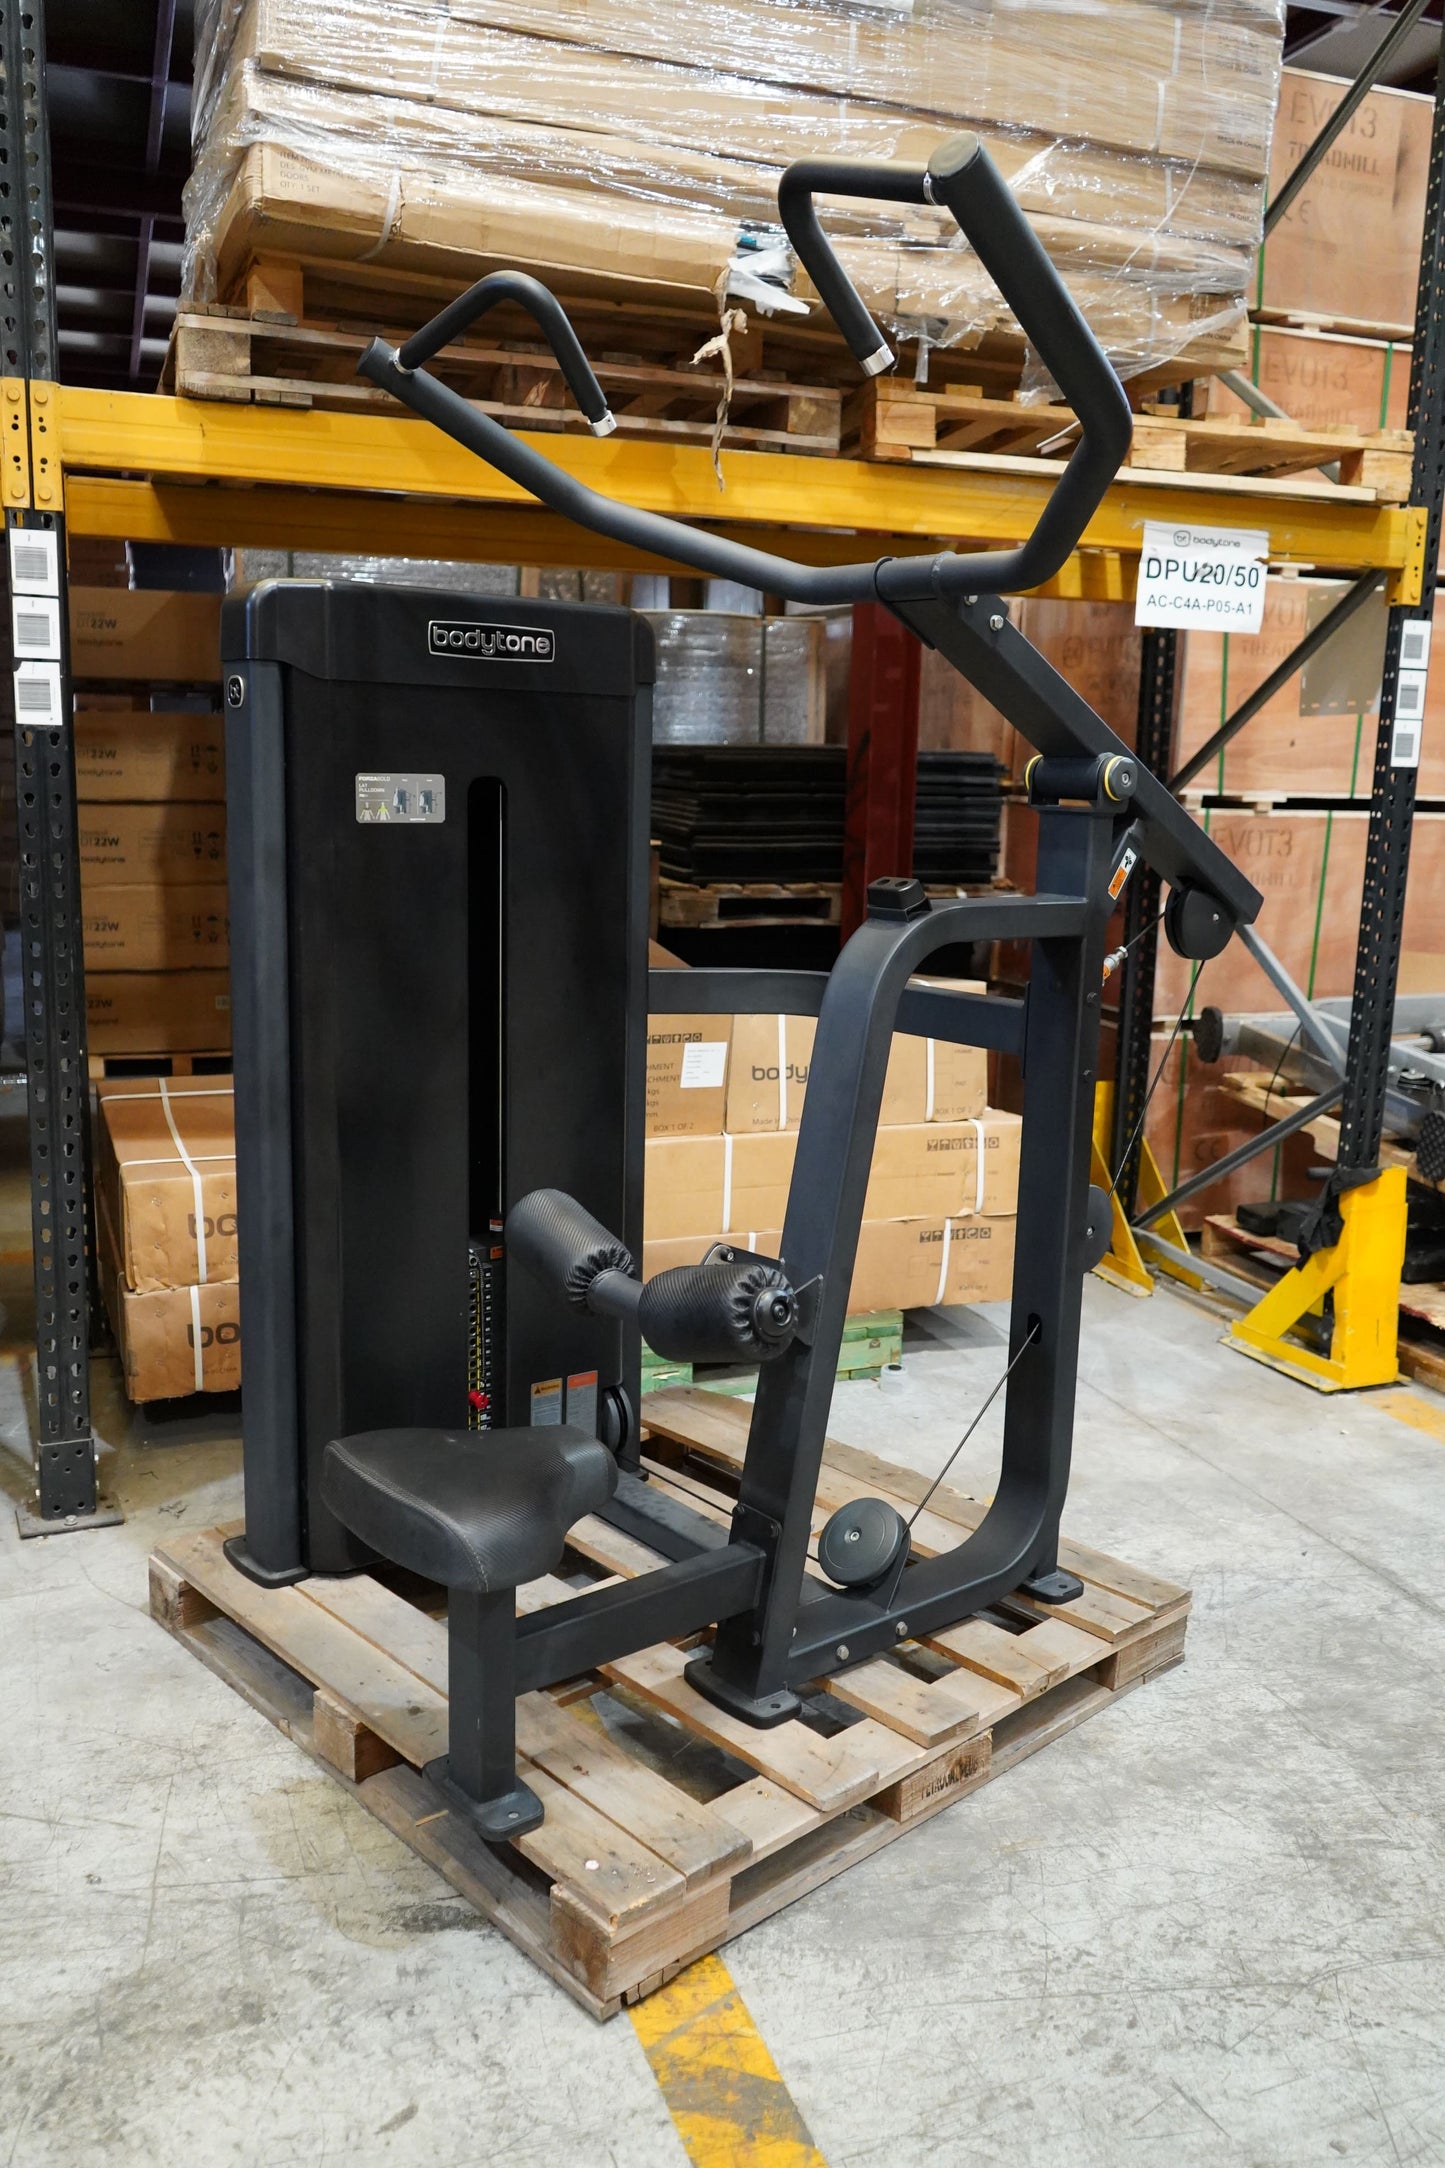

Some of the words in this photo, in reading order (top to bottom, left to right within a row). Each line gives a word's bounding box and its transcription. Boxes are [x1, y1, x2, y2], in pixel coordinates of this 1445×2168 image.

[1192, 536, 1241, 548] bodytone
[1146, 557, 1259, 588] DPU20/50
[1147, 594, 1253, 614] AC-C4A-P05-A1
[433, 626, 551, 656] bodytone
[653, 1124, 669, 1132] BOX
